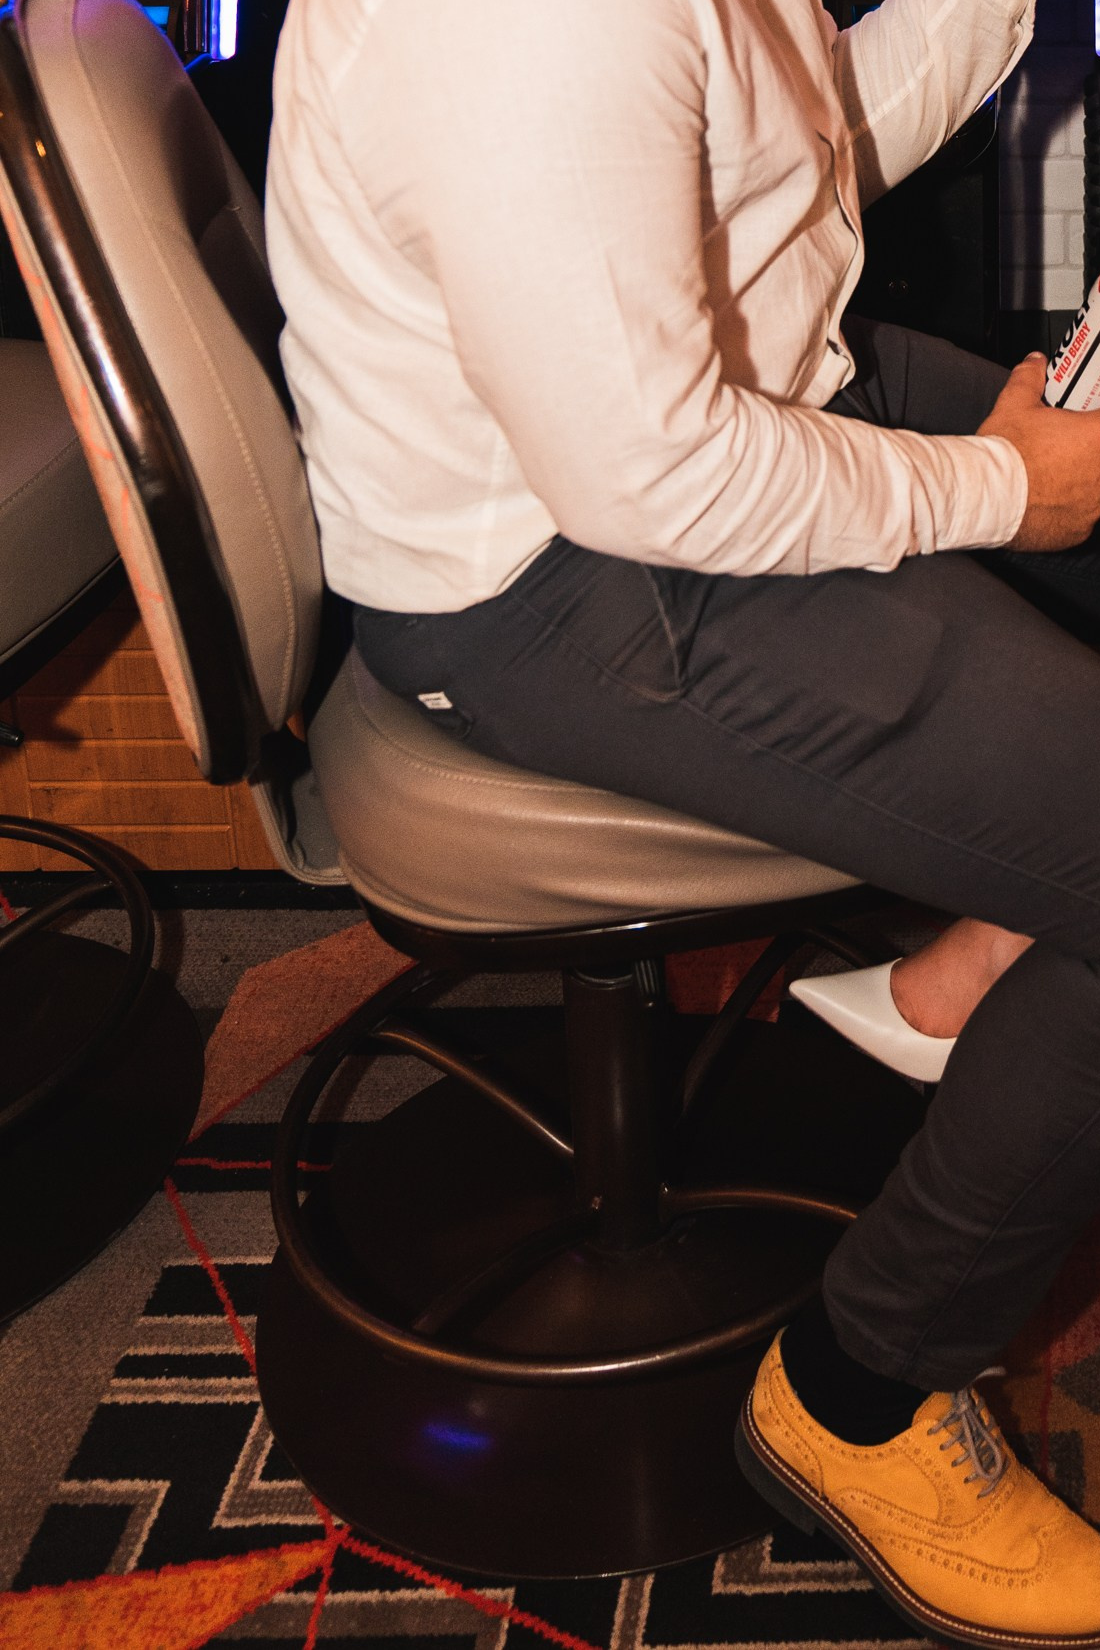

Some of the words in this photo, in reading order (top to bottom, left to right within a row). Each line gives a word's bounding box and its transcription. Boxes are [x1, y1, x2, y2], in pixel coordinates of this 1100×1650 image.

[1053, 356, 1071, 384] WILD
[1068, 322, 1091, 359] BERRY
[1082, 395, 1093, 410] MADE
[1090, 383, 1100, 396] WITH
